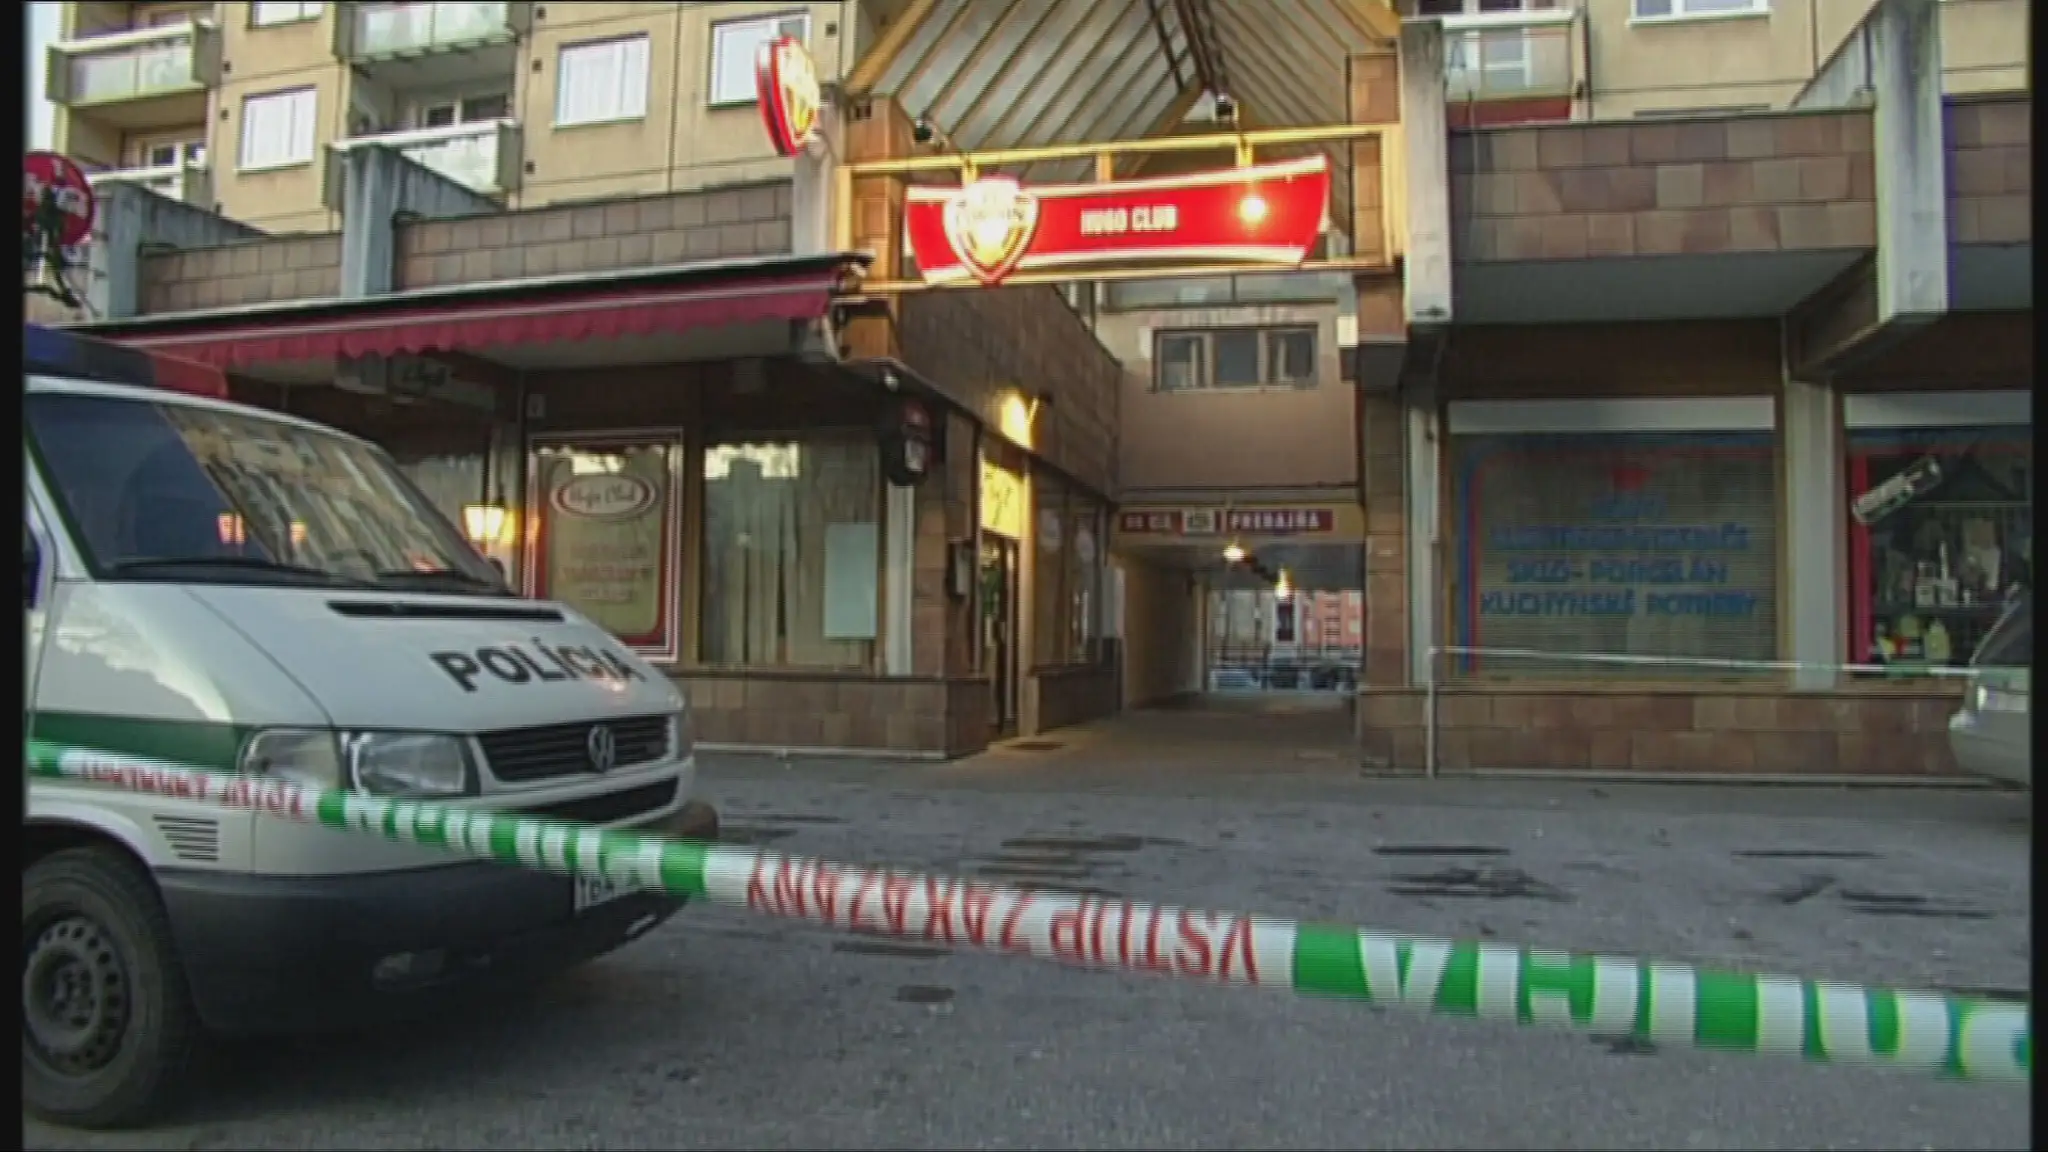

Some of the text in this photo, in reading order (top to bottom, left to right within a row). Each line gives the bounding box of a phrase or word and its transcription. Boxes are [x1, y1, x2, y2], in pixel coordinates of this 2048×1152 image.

[1081, 204, 1179, 236] HUGO CLUB
[429, 635, 647, 692] POLÍCIA
